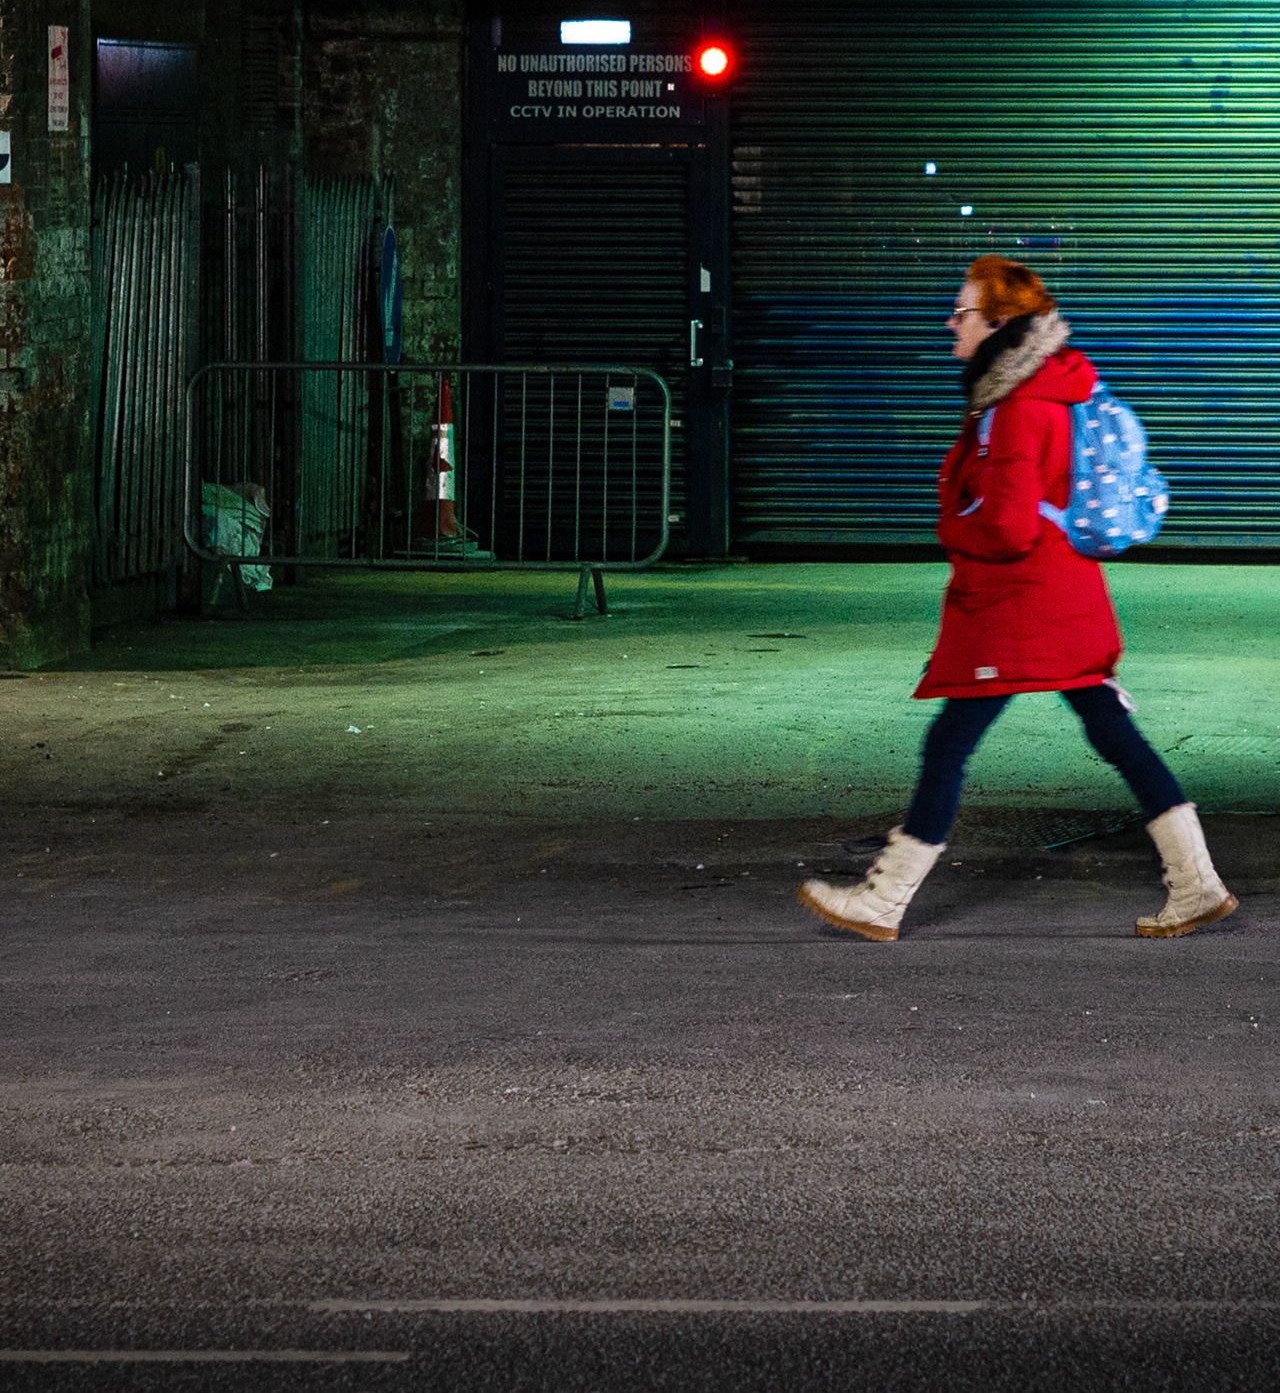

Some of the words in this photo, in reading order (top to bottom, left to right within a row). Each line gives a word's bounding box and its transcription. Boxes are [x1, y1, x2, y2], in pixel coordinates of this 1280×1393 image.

[497, 54, 517, 73] NO
[520, 54, 626, 73] UNAUTHORISED
[629, 54, 693, 73] PERSONS
[528, 80, 583, 98] BEYOND
[585, 80, 618, 98] THIS
[621, 80, 663, 98] POINT
[510, 105, 553, 118] CCTV
[557, 106, 577, 118] IN
[582, 105, 681, 118] OPERATION
